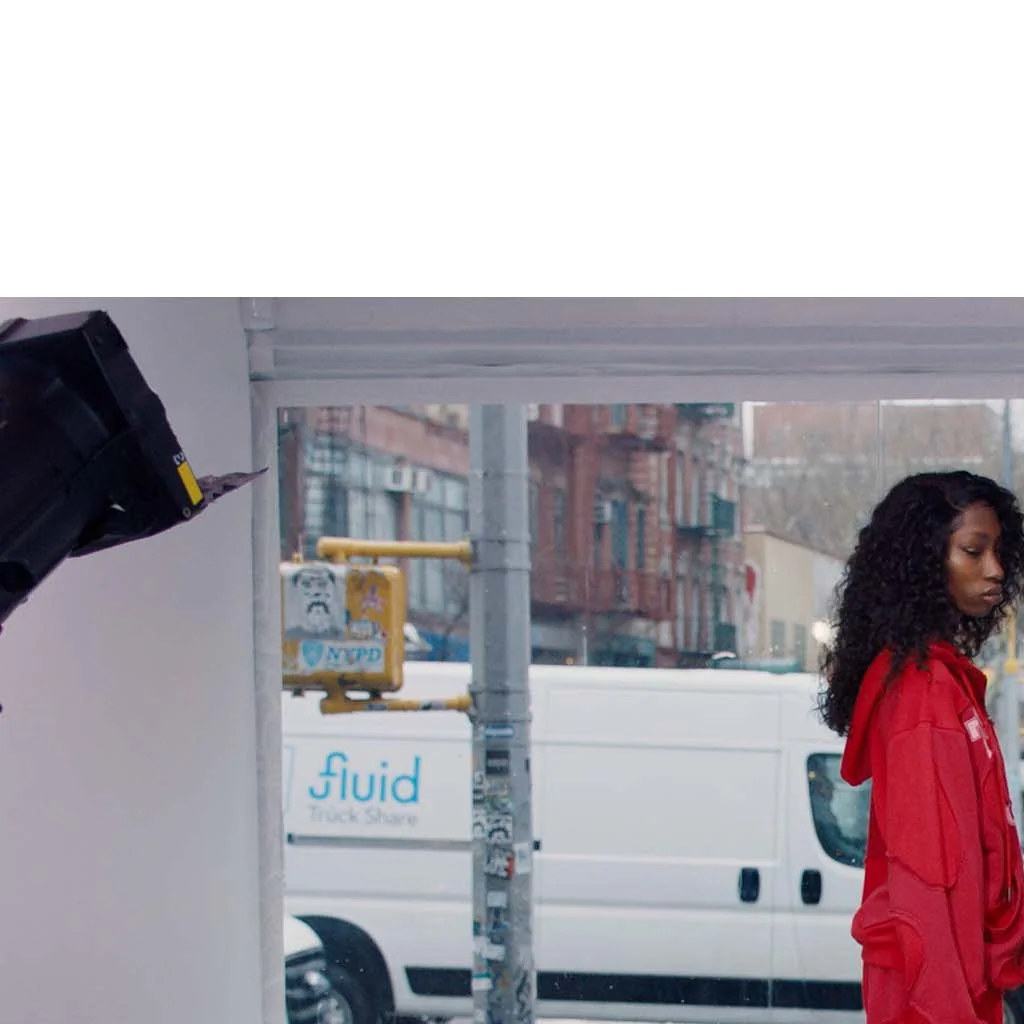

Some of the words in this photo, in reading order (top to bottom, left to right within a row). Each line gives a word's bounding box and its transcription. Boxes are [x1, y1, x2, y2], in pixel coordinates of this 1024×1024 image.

[326, 646, 382, 663] NYPD
[308, 751, 421, 804] fluid
[308, 803, 359, 823] Truck
[364, 805, 418, 828] Share
